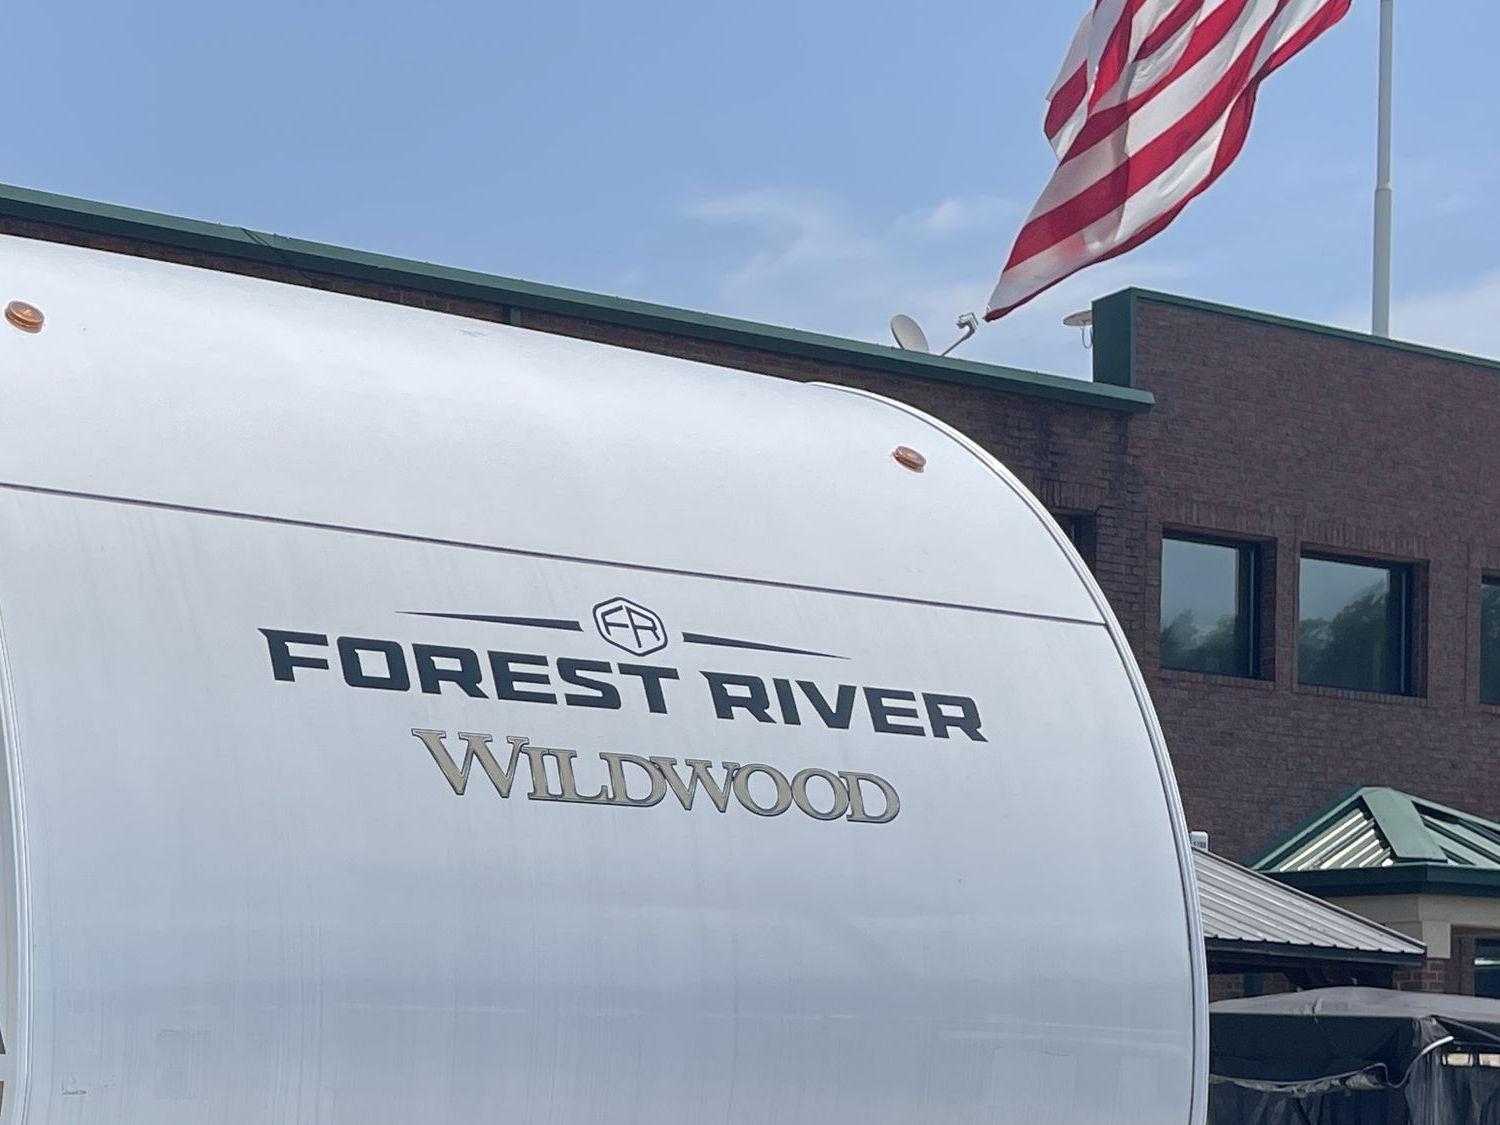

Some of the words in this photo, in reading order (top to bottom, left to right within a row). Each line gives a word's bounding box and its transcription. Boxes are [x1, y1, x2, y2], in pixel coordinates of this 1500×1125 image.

[257, 627, 680, 714] FOREST
[699, 670, 989, 743] RIVER
[411, 728, 901, 824] WILDWOOD
